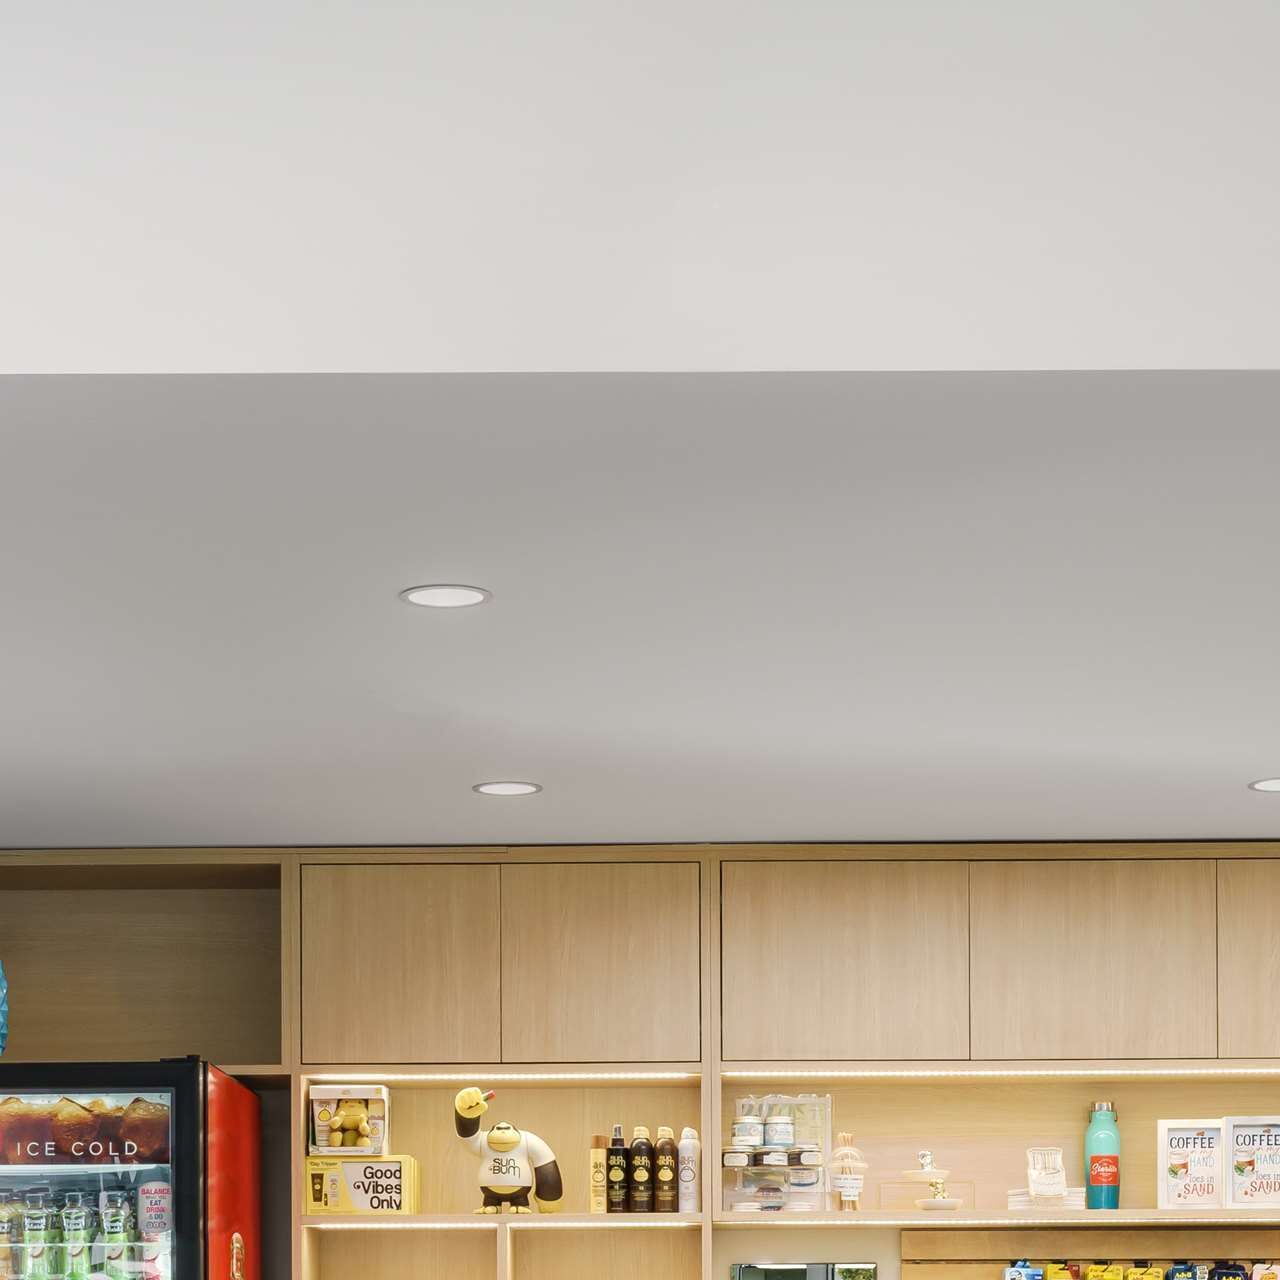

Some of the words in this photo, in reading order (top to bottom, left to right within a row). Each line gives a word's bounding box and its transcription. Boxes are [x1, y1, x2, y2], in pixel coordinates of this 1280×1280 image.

[1169, 1136, 1215, 1149] COFFEE
[1235, 1134, 1280, 1147] COFFEE
[16, 1141, 57, 1157] ICE
[71, 1141, 138, 1157] COLD
[1190, 1156, 1215, 1168] HAND
[1256, 1154, 1280, 1165] HAND
[363, 1165, 402, 1180] Good
[140, 1187, 171, 1195] BALANCE
[353, 1180, 402, 1195] Vibes
[1183, 1183, 1215, 1197] SAND
[1250, 1180, 1280, 1194] SAND
[369, 1195, 402, 1211] Only
